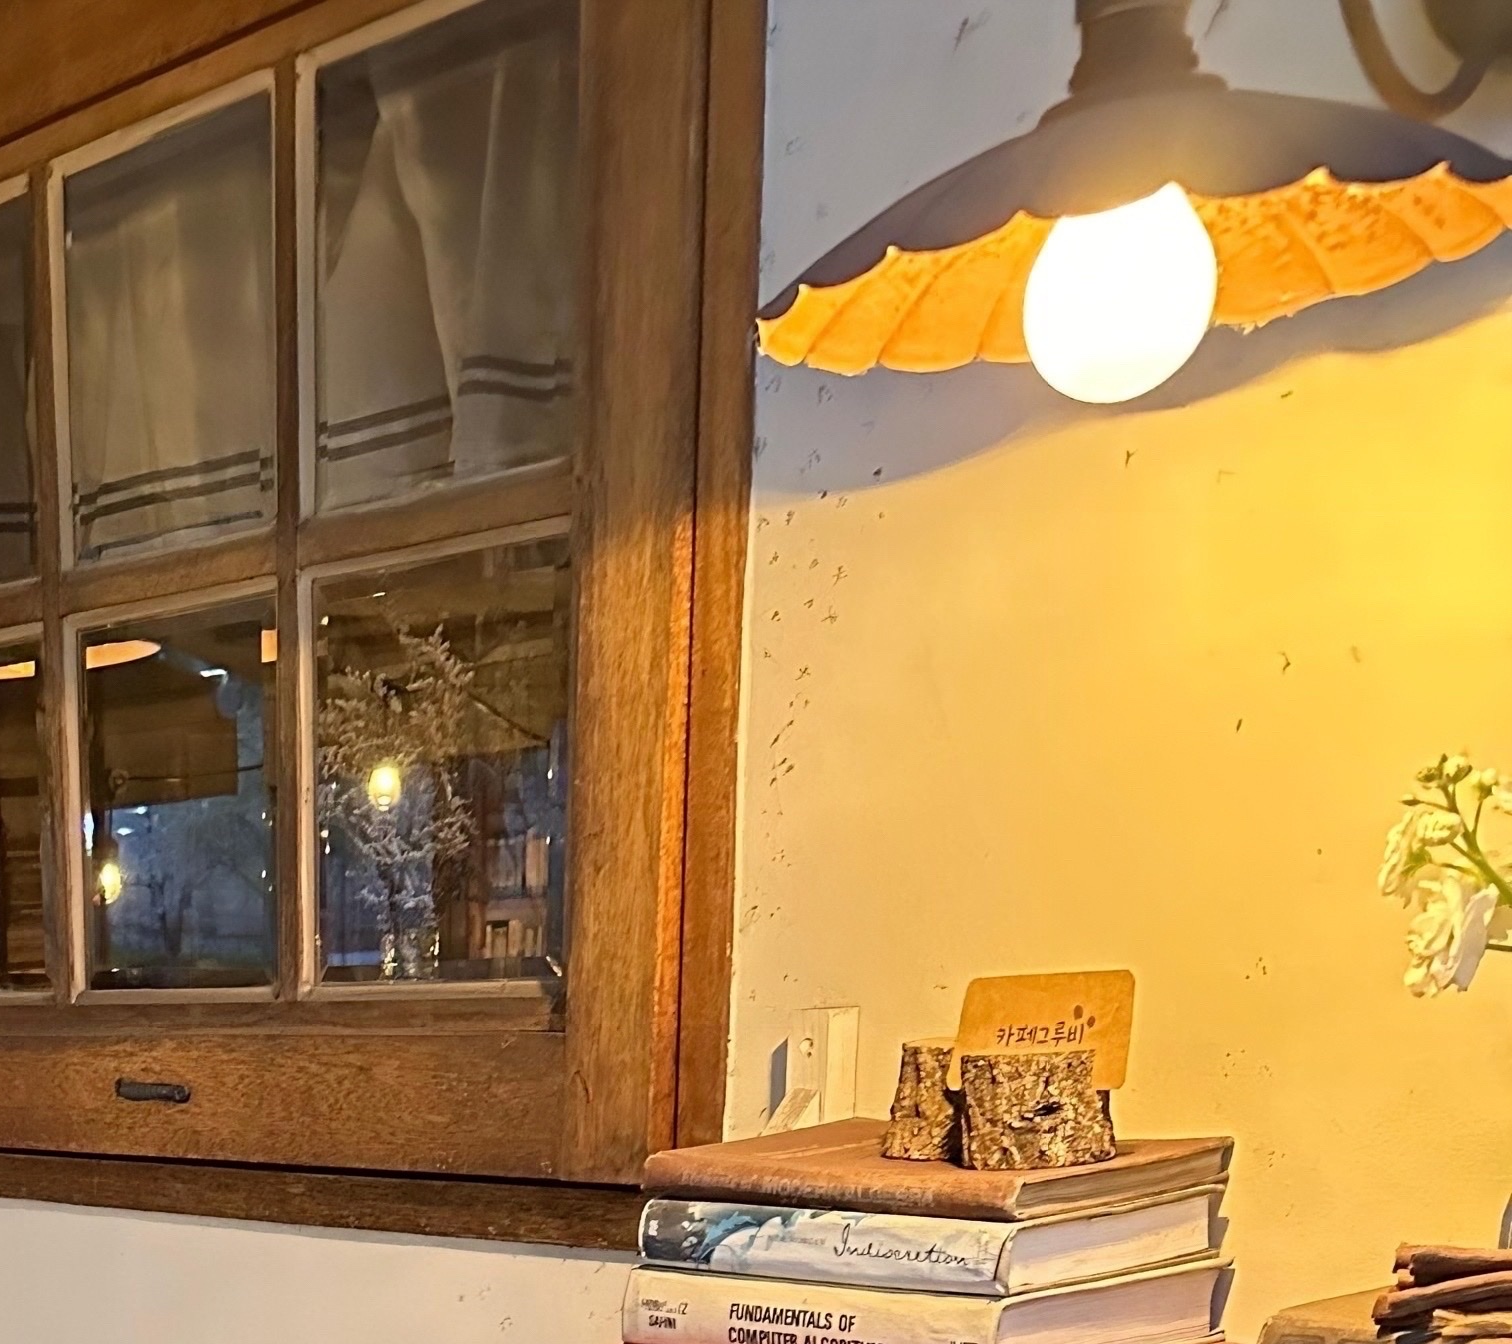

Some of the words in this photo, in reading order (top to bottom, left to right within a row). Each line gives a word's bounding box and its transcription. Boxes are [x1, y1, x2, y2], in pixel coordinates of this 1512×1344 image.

[996, 1020, 1085, 1047] 카페그루비
[833, 1222, 969, 1266] Indiscretion
[729, 1303, 833, 1331] FUNDAMENTALS
[839, 1315, 857, 1333] OF
